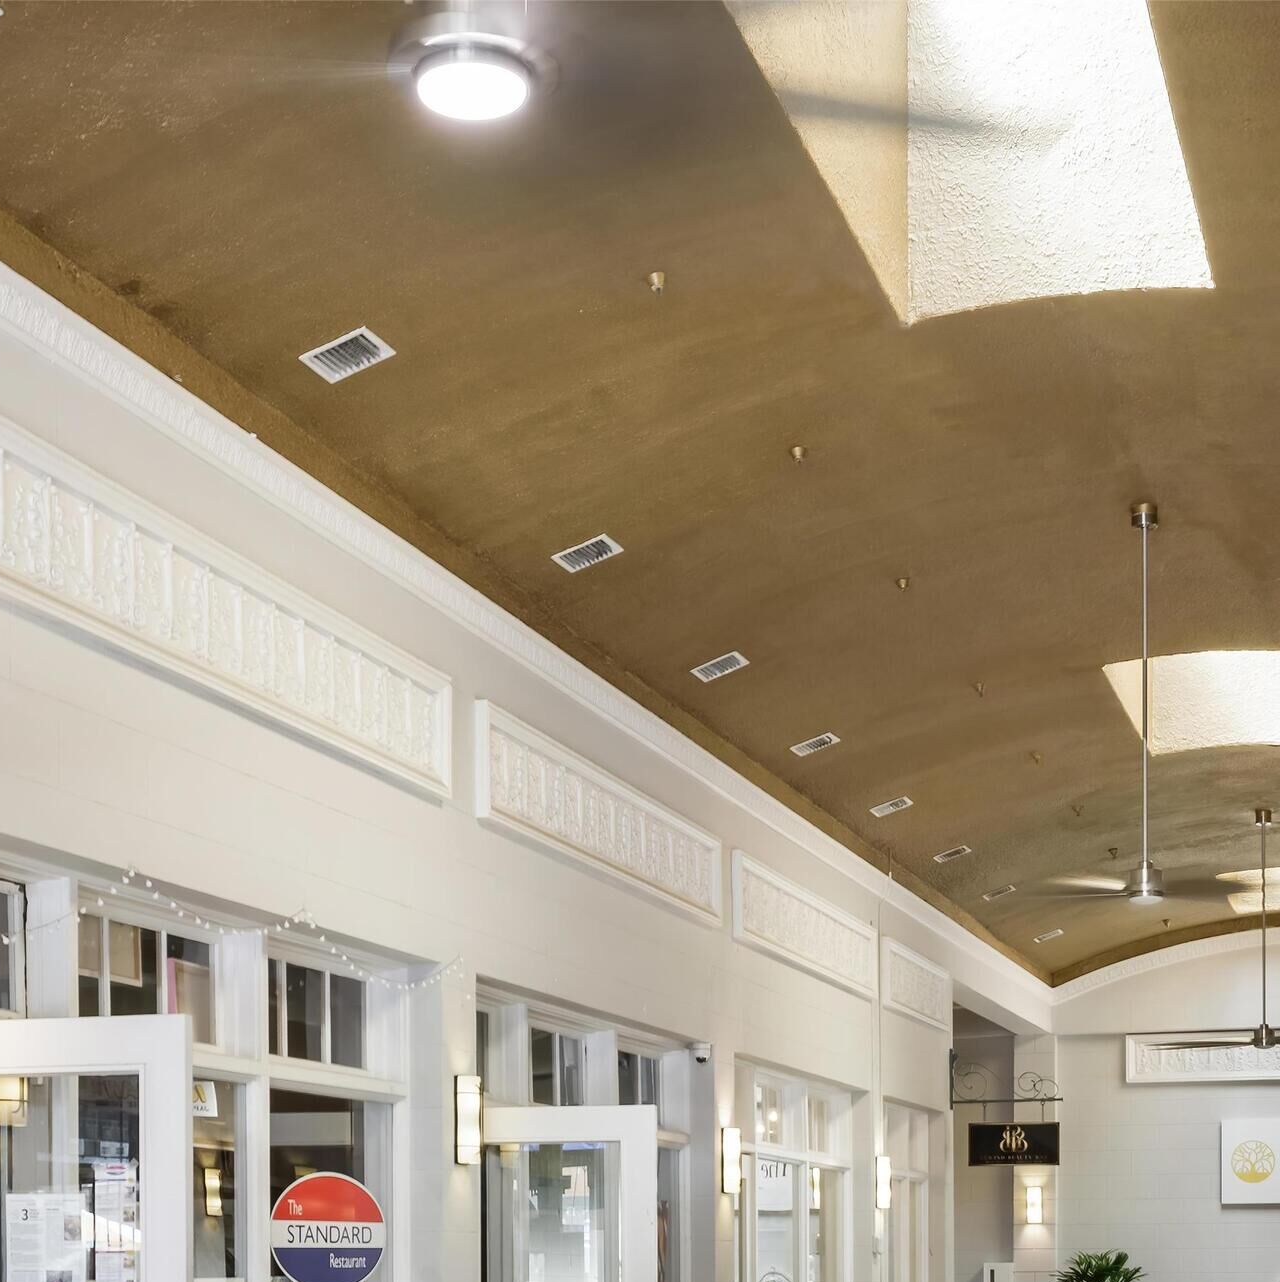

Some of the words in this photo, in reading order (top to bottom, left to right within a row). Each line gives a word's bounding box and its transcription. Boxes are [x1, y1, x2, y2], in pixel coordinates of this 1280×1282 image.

[288, 1199, 302, 1215] The
[288, 1225, 372, 1243] STANDARD
[330, 1253, 367, 1268] Restaurant
